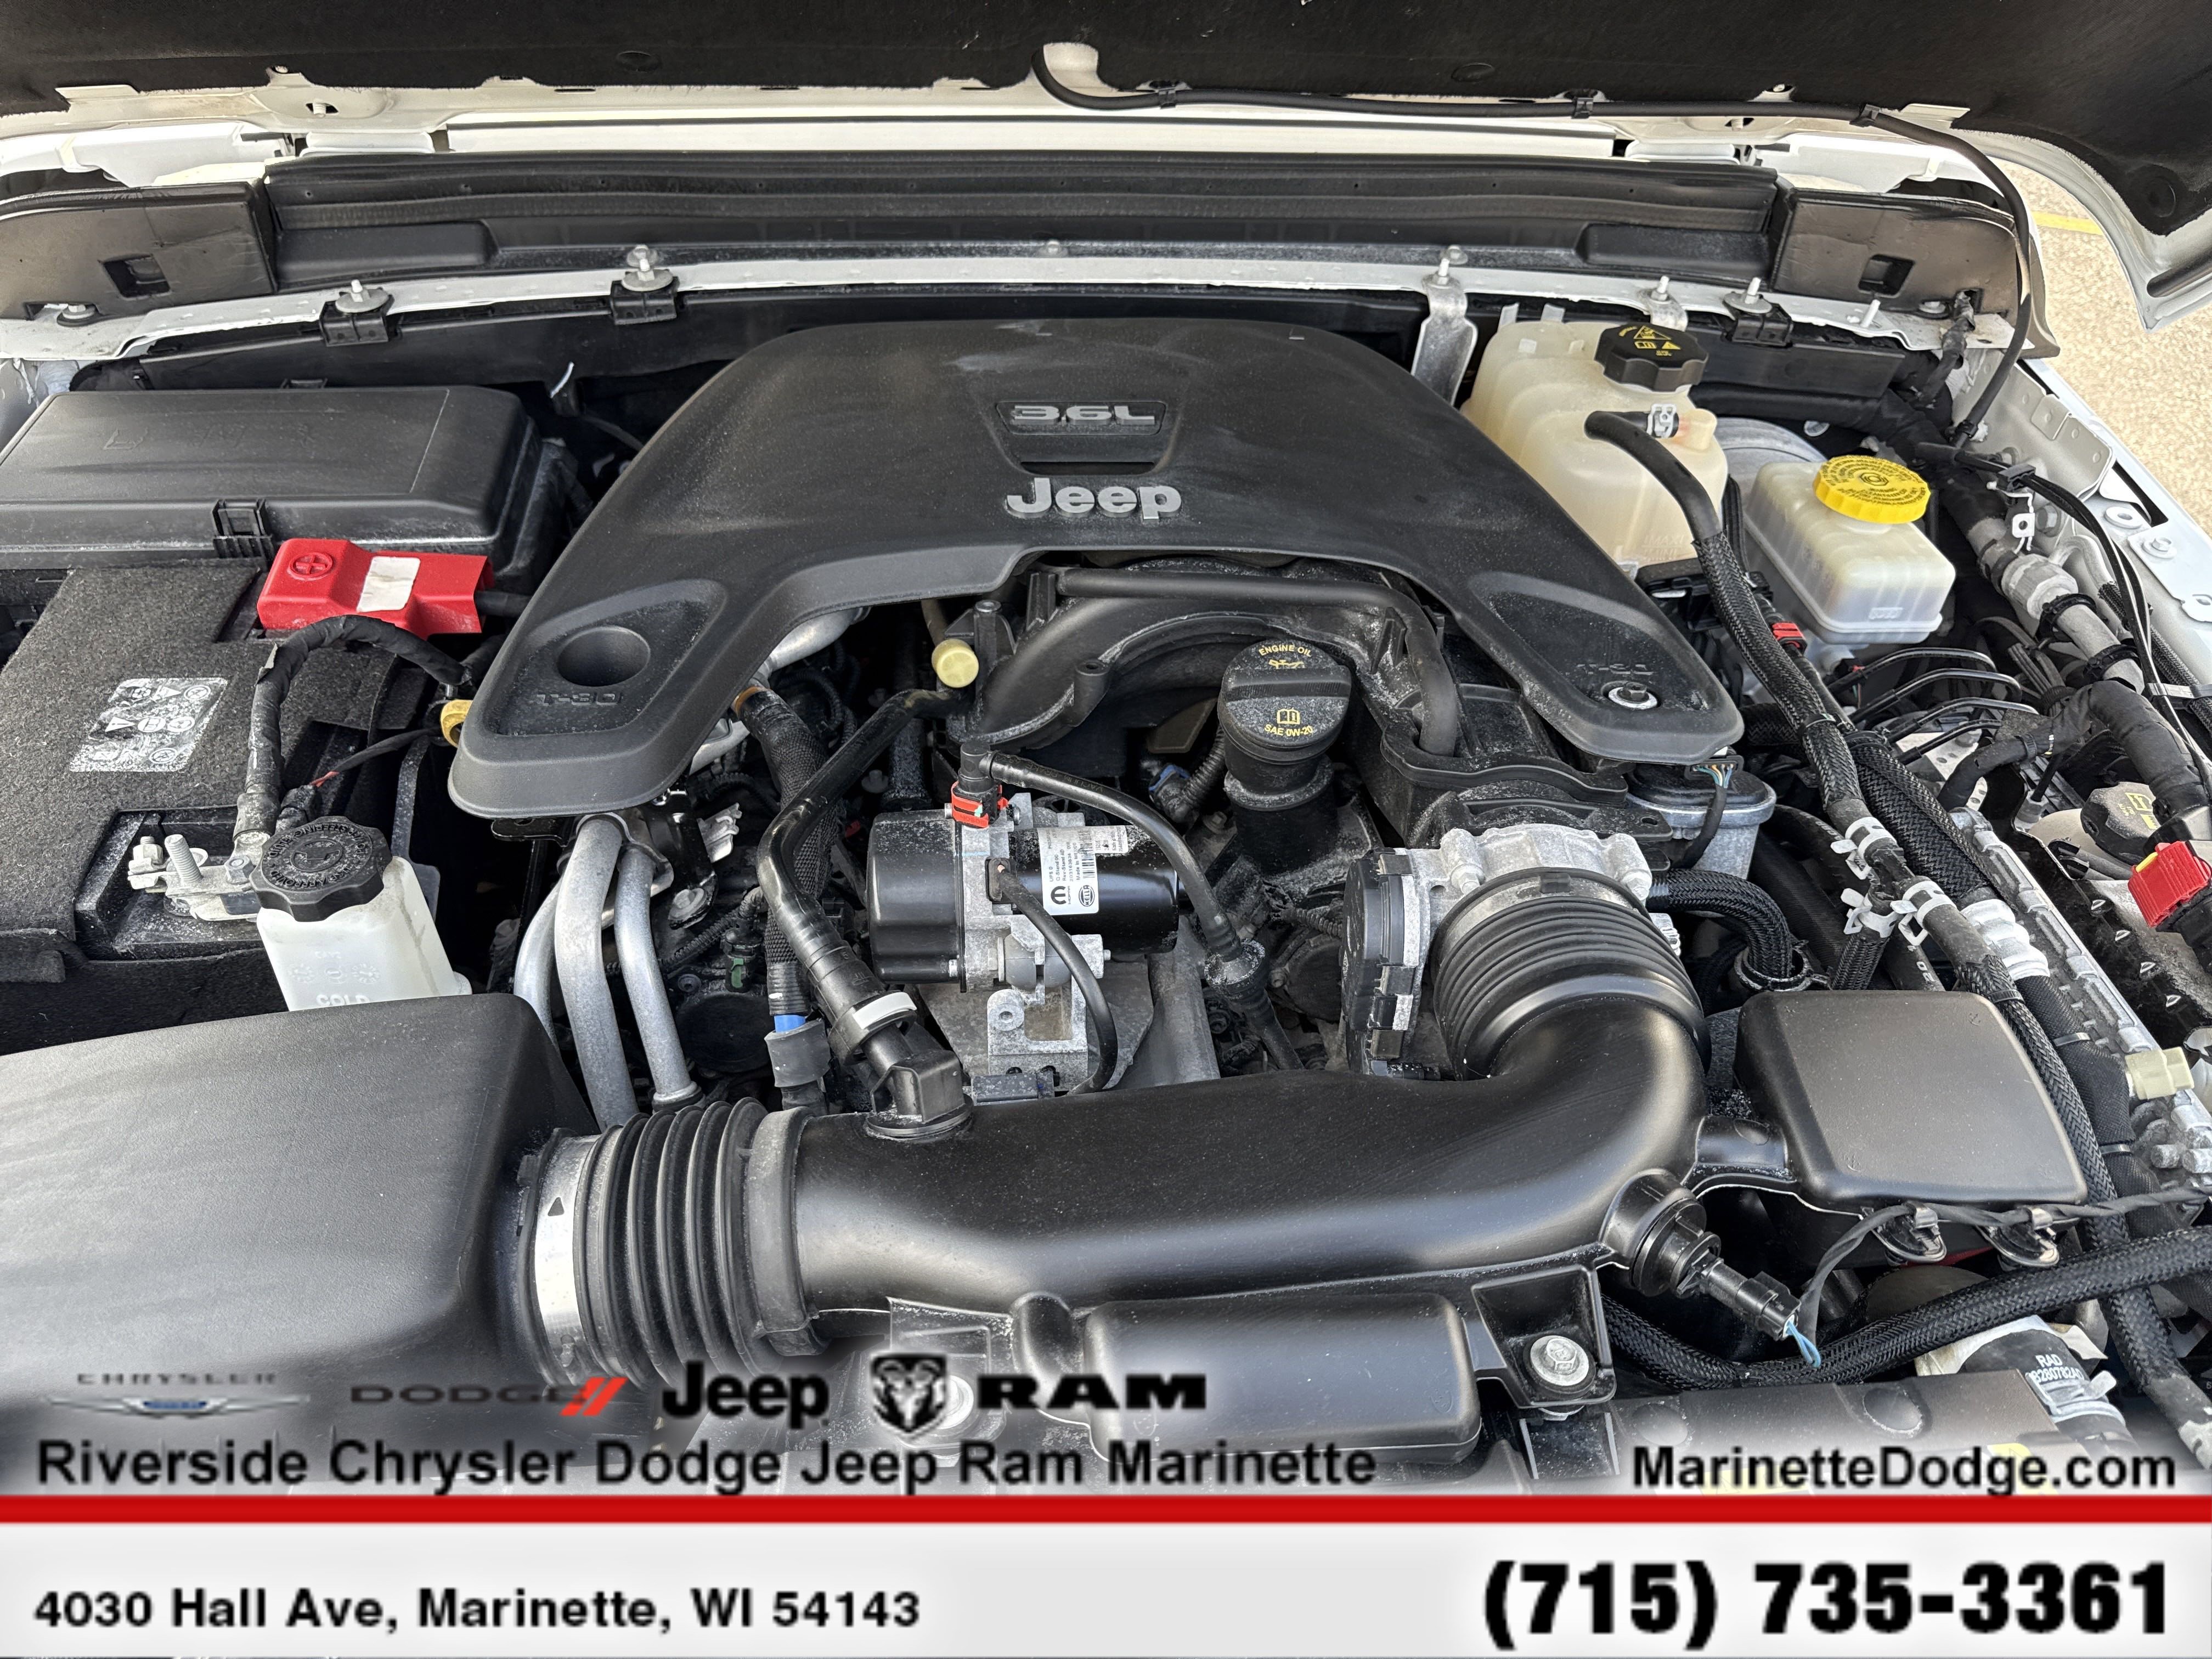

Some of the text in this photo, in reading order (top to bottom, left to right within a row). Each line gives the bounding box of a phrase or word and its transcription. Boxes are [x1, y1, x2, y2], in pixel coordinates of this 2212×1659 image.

[1011, 405, 1155, 425] 3.6L
[1005, 477, 1182, 520] Jeep
[1259, 645, 1312, 658] ENGINE OIL
[537, 693, 622, 706] T-30
[1264, 724, 1313, 737] SAE 0W-20
[294, 823, 348, 837] STEERING
[270, 870, 327, 887] APPROVED
[2035, 1354, 2063, 1367] RAD
